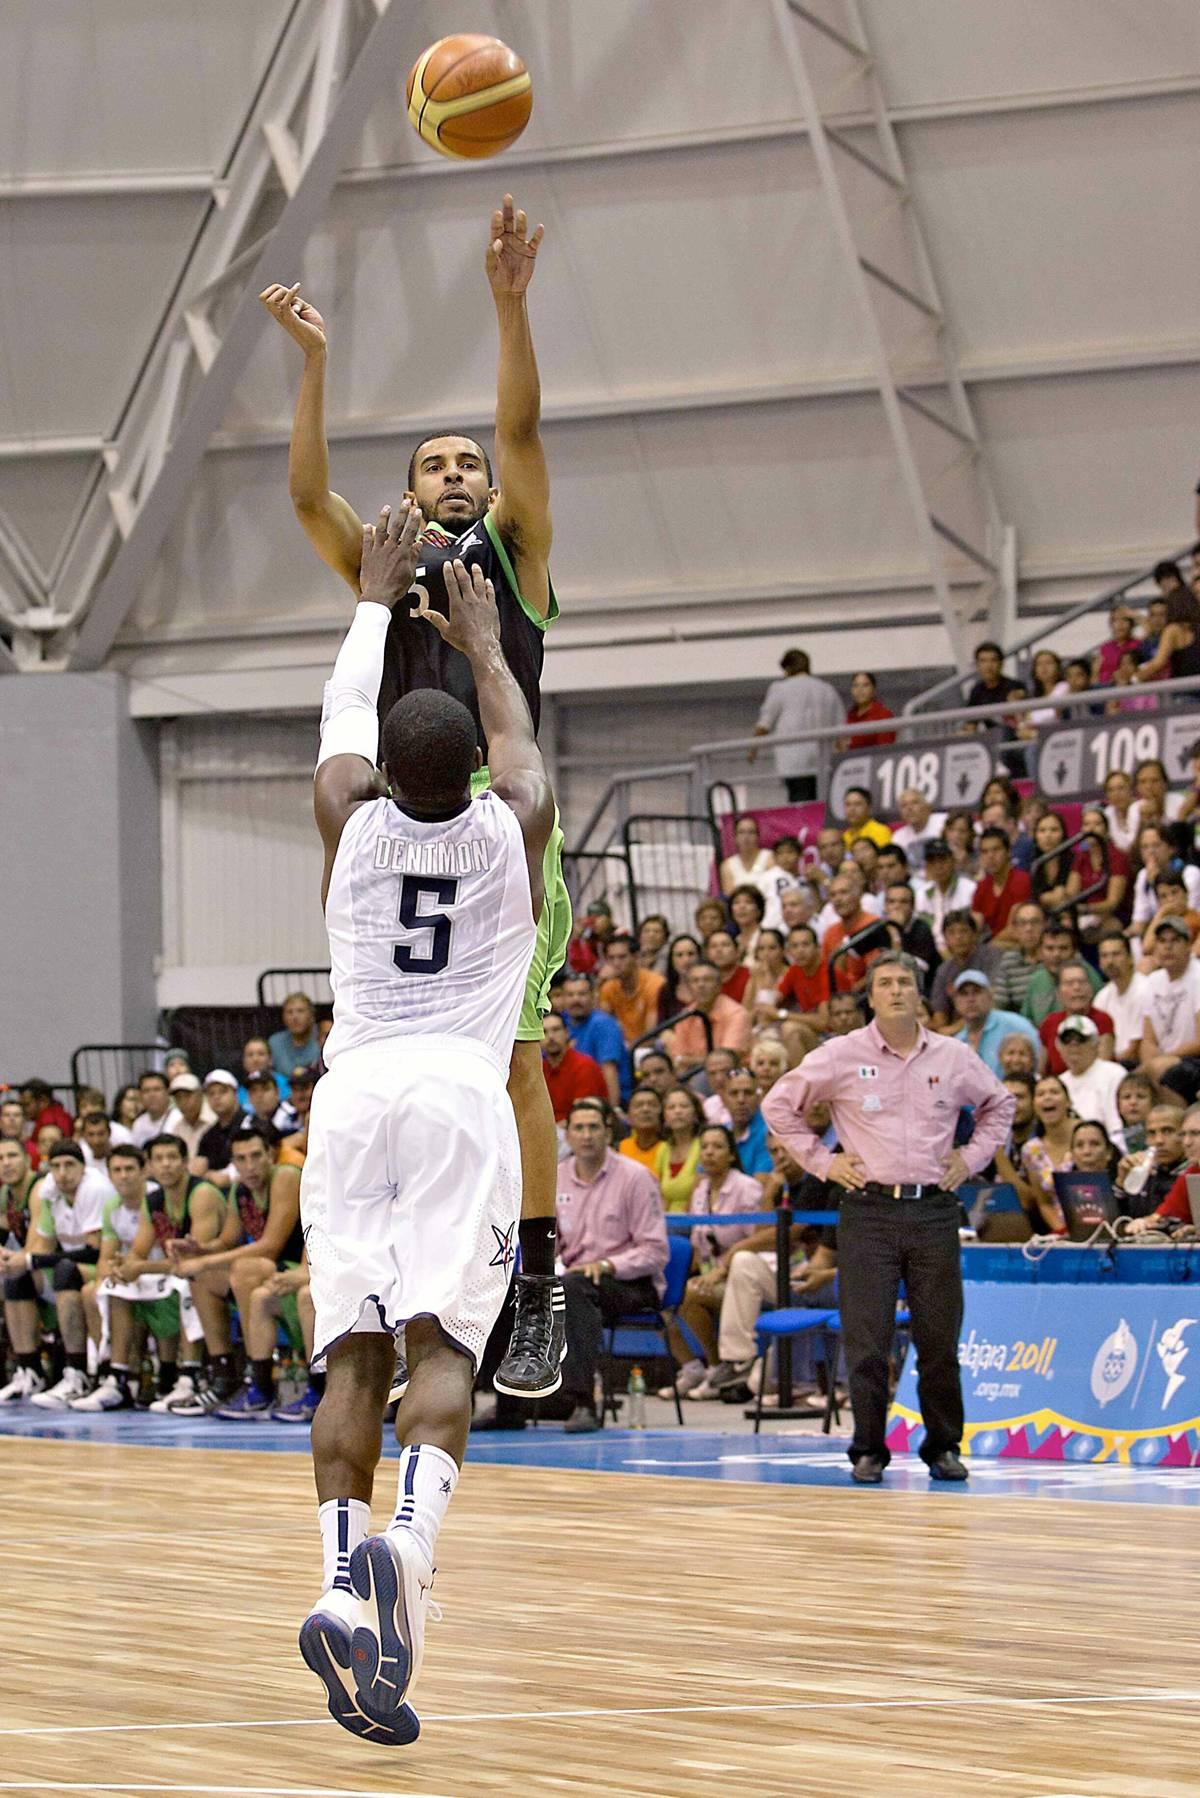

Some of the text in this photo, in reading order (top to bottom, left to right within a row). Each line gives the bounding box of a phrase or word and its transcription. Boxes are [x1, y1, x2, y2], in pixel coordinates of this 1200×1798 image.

[876, 752, 940, 810] 108
[1090, 723, 1159, 786] 109
[373, 834, 491, 876] DENTMON
[391, 872, 462, 976] 5
[957, 1329, 1057, 1379] alajara 2011
